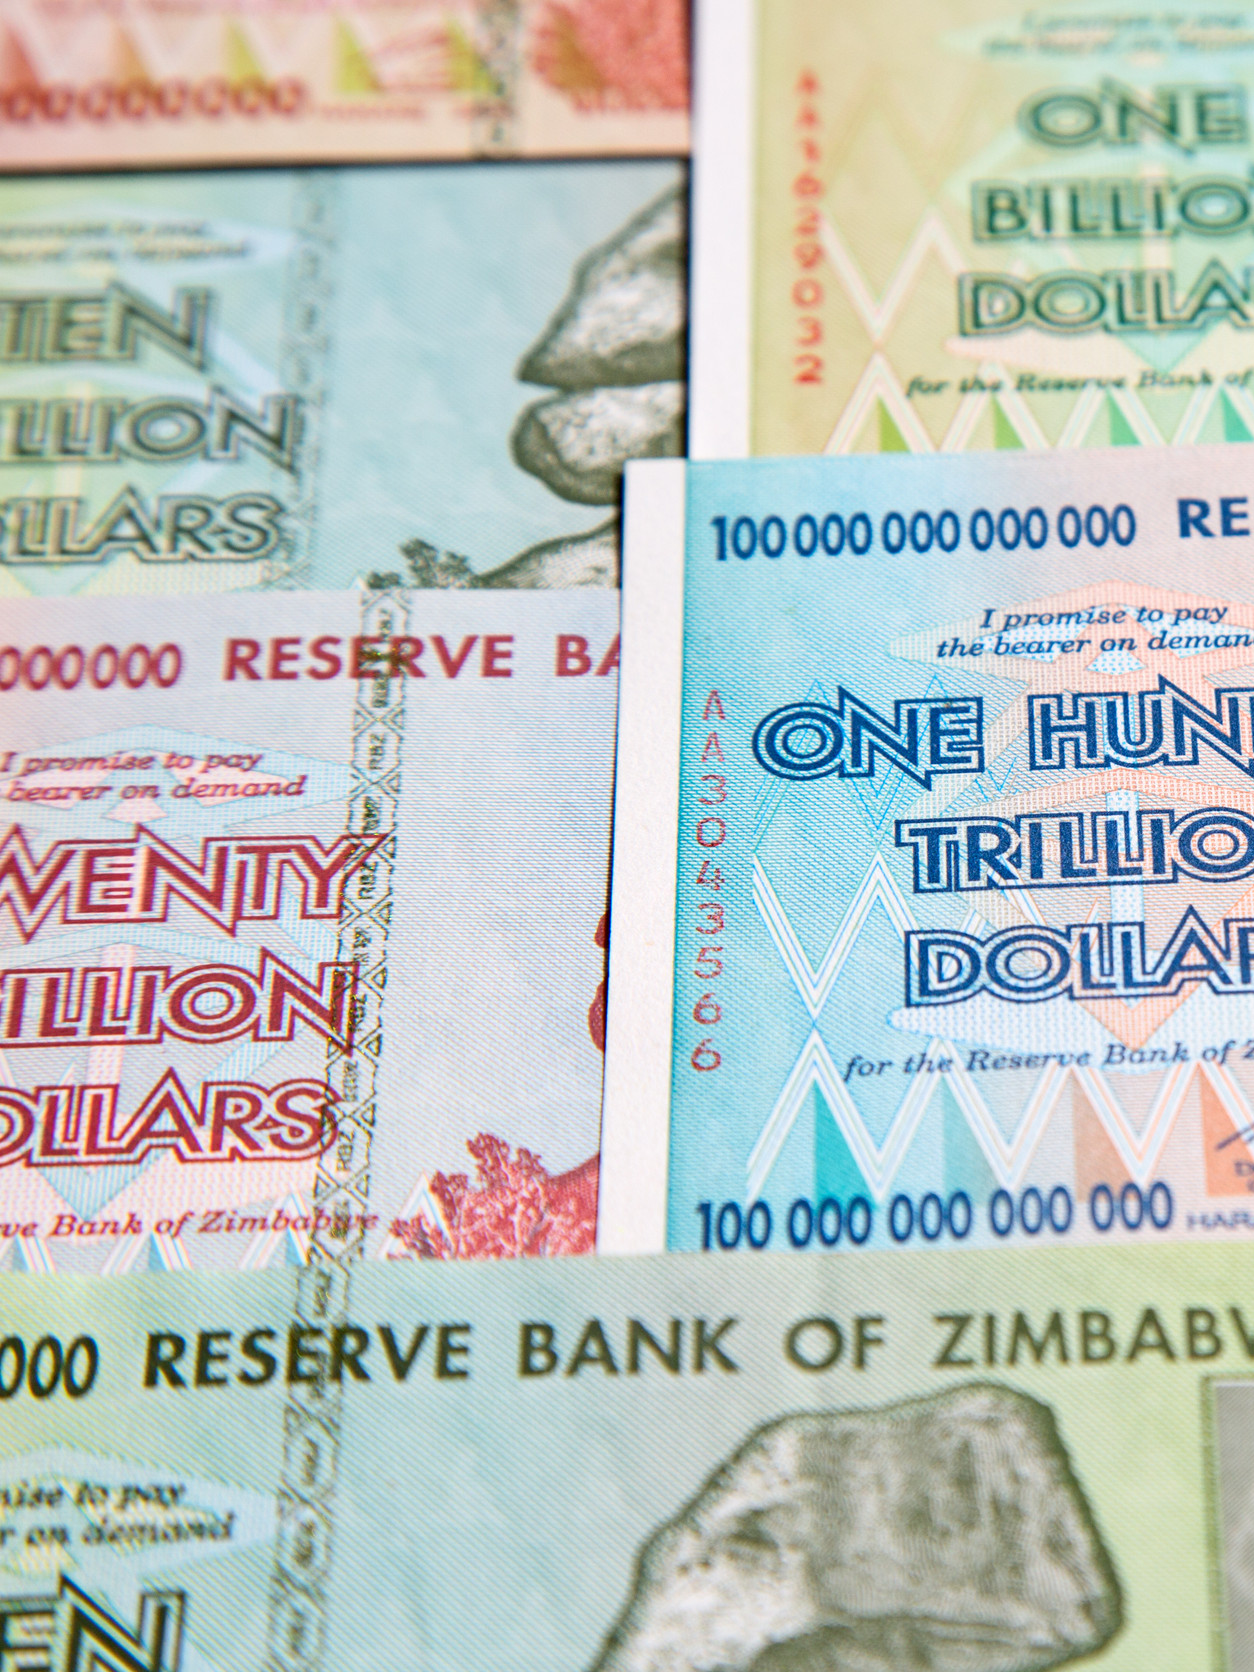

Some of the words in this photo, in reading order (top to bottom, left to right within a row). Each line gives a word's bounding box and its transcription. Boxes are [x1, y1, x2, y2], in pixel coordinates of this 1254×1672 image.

[1015, 76, 1254, 156] ONE
[1138, 367, 1214, 389] Bank
[0, 483, 290, 565] LLARS
[979, 608, 997, 629] I
[1002, 605, 1128, 634] promise
[1134, 605, 1164, 625] to
[1171, 603, 1230, 629] pay
[222, 633, 515, 681] RESERVE
[935, 637, 985, 658] the
[992, 632, 1092, 657] bearer
[1099, 633, 1139, 653] on
[750, 685, 985, 793] ONE
[20, 750, 156, 778] promise
[163, 751, 195, 770] to
[200, 753, 264, 774] pay
[7, 779, 112, 801] bearer
[119, 784, 161, 800] on
[170, 775, 308, 799] demand
[844, 1054, 893, 1083] for
[903, 1049, 953, 1075] the
[965, 1046, 1095, 1073] Reserve
[1103, 1041, 1191, 1067] Bank
[1201, 1040, 1236, 1065] of
[50, 1211, 143, 1238] Bank
[153, 1209, 191, 1239] of
[697, 1201, 772, 1252] 100
[787, 1196, 873, 1248] 000
[889, 1191, 973, 1243] 000
[989, 1185, 1074, 1238] 000
[1088, 1180, 1175, 1233] 000
[142, 1322, 472, 1389] RESERVE
[516, 1316, 738, 1379] BANK
[784, 1314, 886, 1371] OF
[81, 1509, 238, 1546] demand
